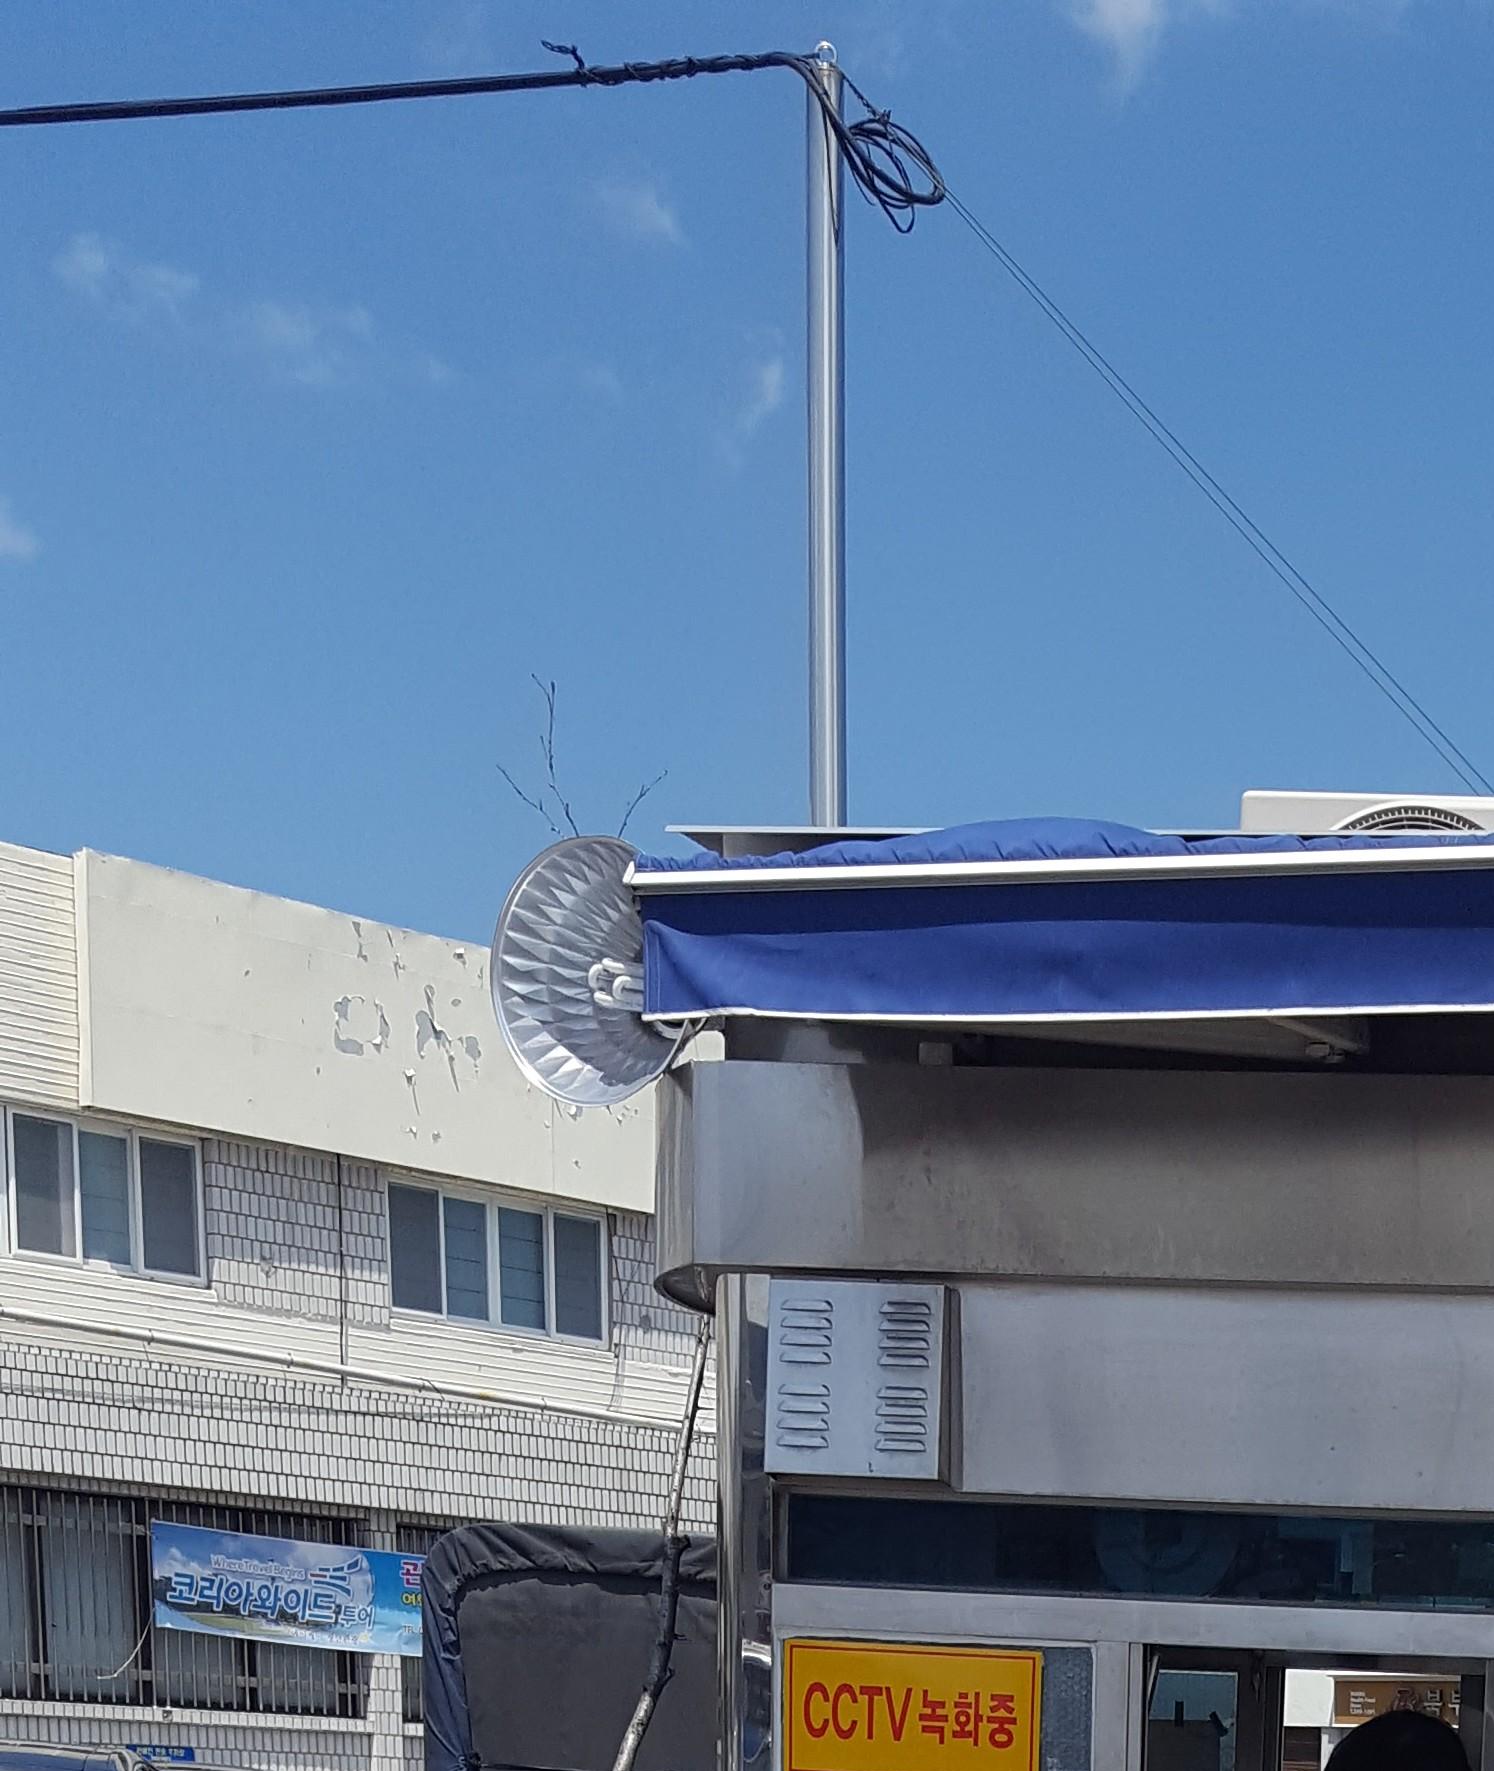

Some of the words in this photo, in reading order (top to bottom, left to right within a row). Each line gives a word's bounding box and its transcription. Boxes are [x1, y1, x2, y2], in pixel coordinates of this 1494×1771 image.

[168, 1572, 335, 1621] 코리아와이드
[341, 1607, 374, 1626] 투어
[803, 1682, 912, 1741] CCTV
[918, 1689, 1017, 1749] 녹화중
